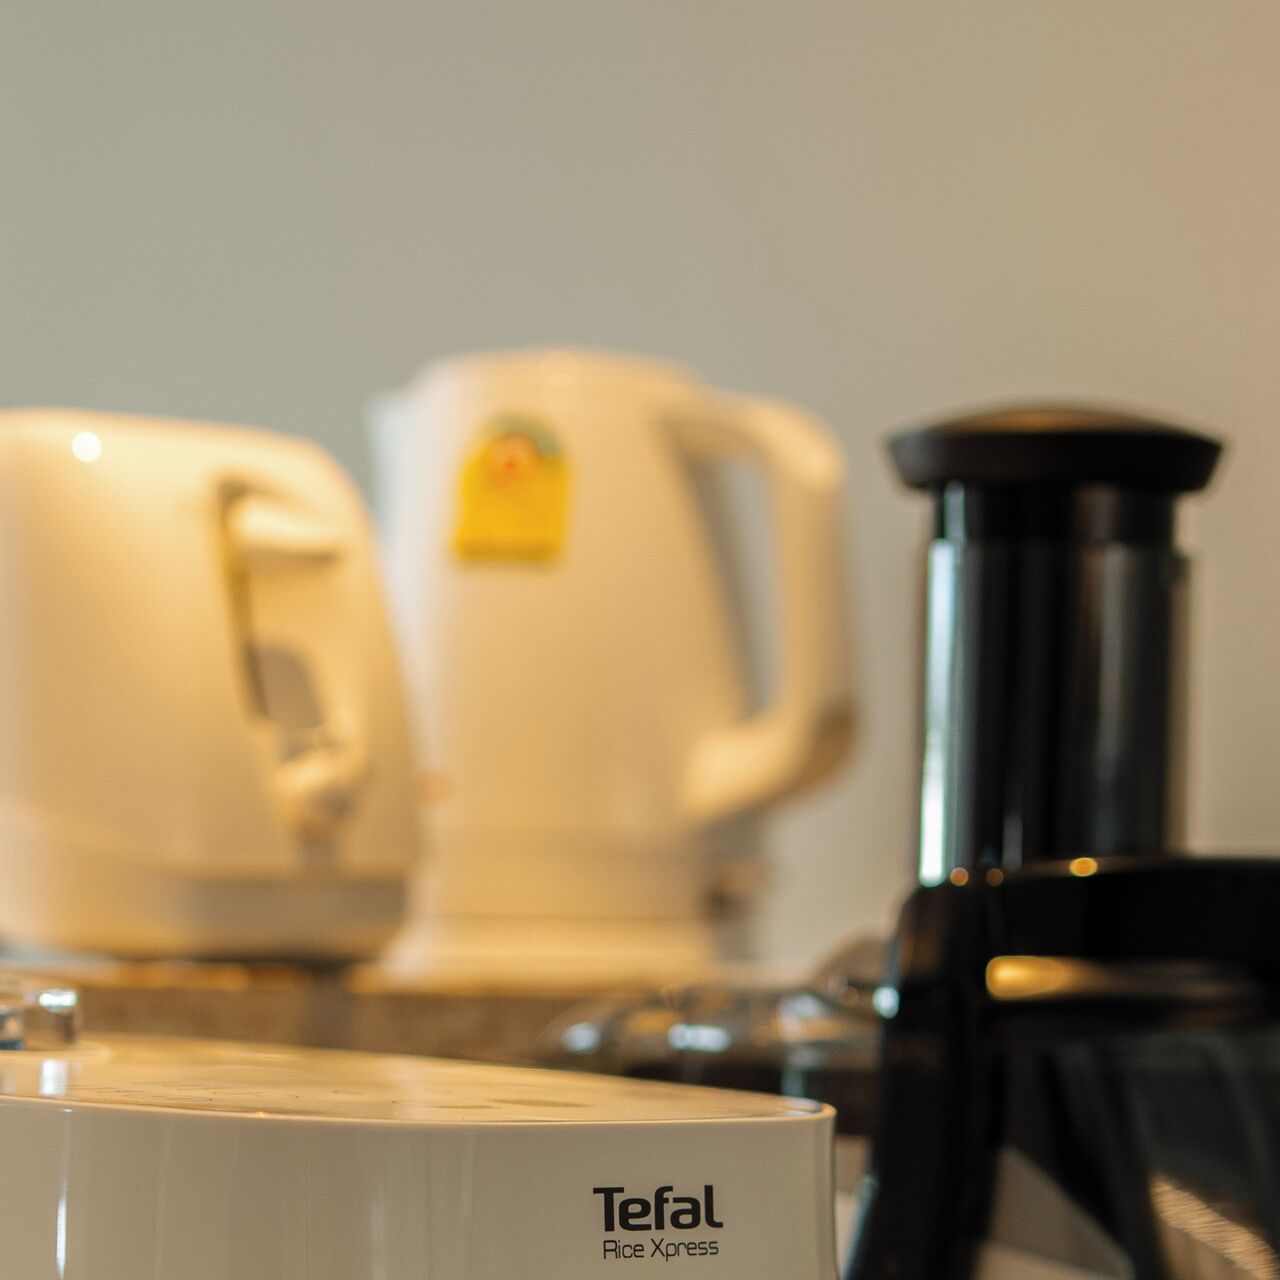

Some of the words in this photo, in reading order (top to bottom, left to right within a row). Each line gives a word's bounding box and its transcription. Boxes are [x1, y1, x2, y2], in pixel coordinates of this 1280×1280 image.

[593, 1185, 723, 1232] Tefal
[603, 1239, 645, 1260] Rice
[650, 1238, 719, 1262] Xpress
